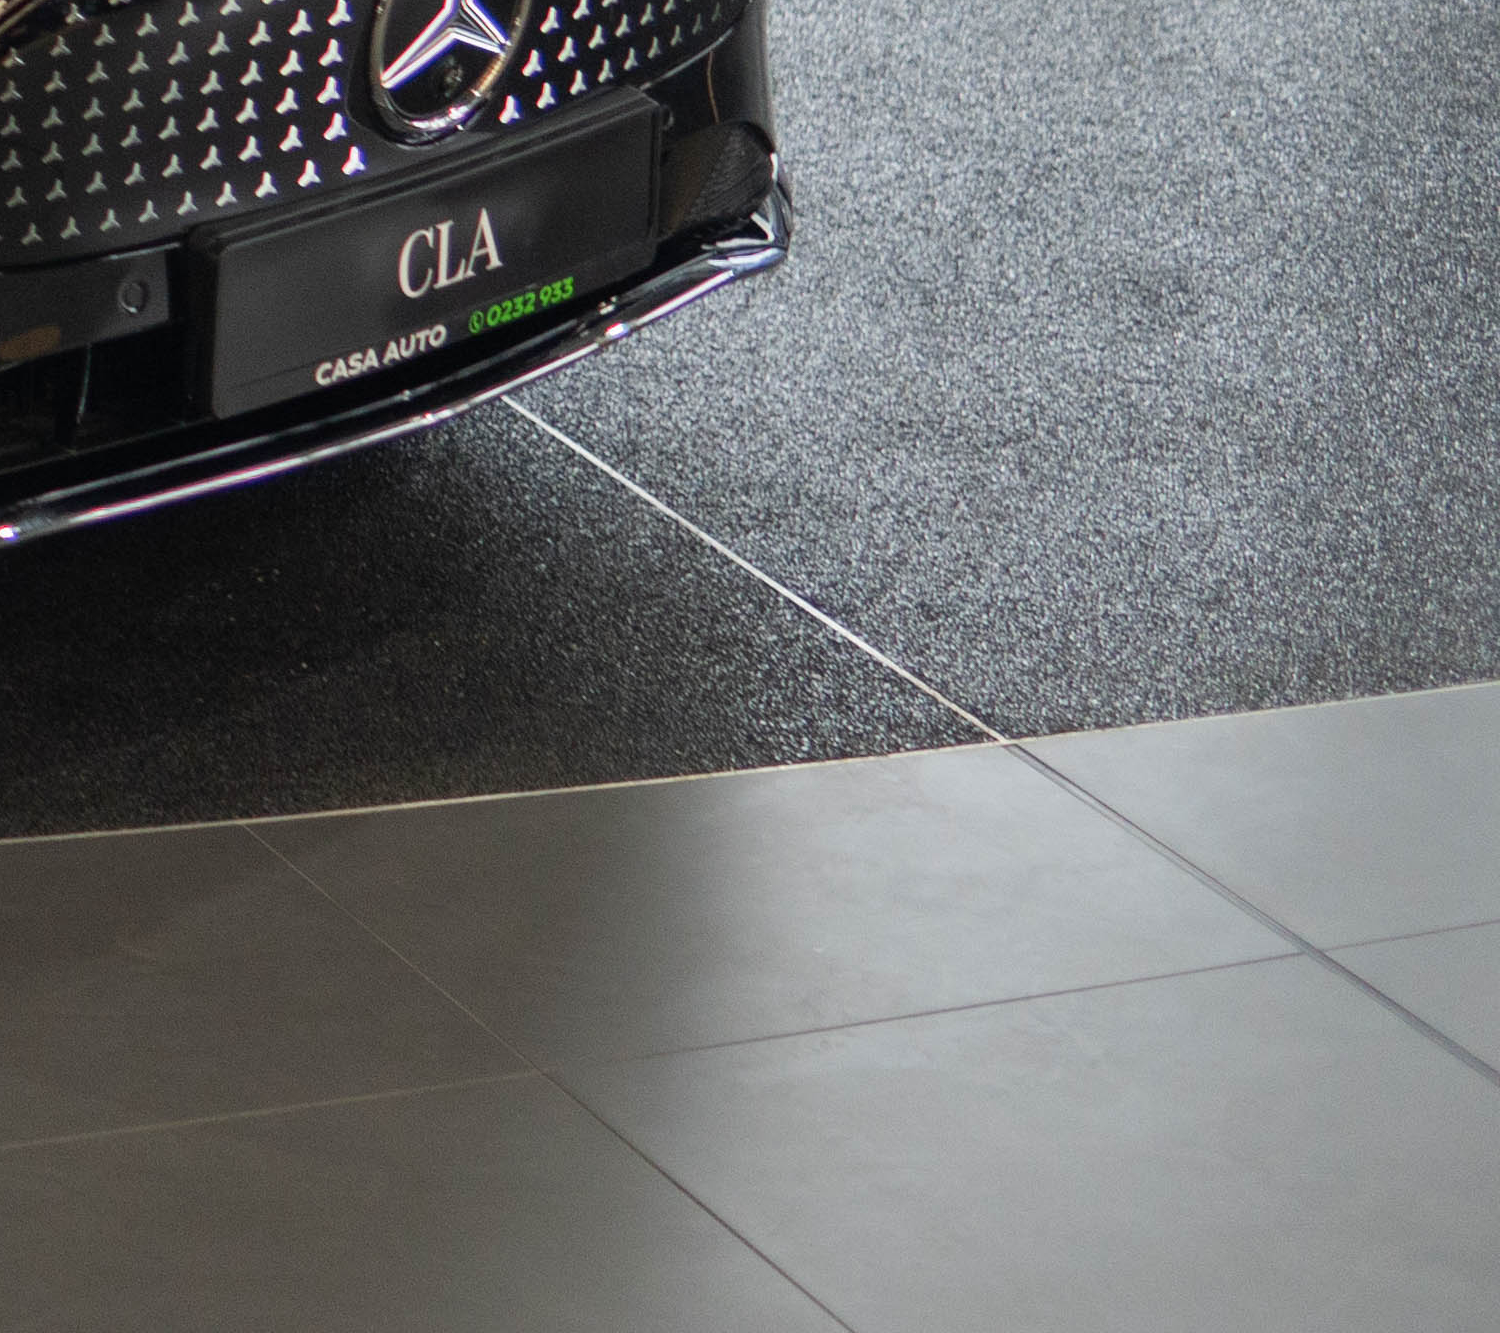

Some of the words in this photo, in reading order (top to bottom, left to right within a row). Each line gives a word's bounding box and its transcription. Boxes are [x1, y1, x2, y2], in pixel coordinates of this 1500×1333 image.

[398, 207, 503, 299] CLA
[486, 291, 536, 327] 0232
[539, 276, 574, 307] 933
[315, 348, 379, 385] CASA
[383, 324, 447, 365] AUTO
